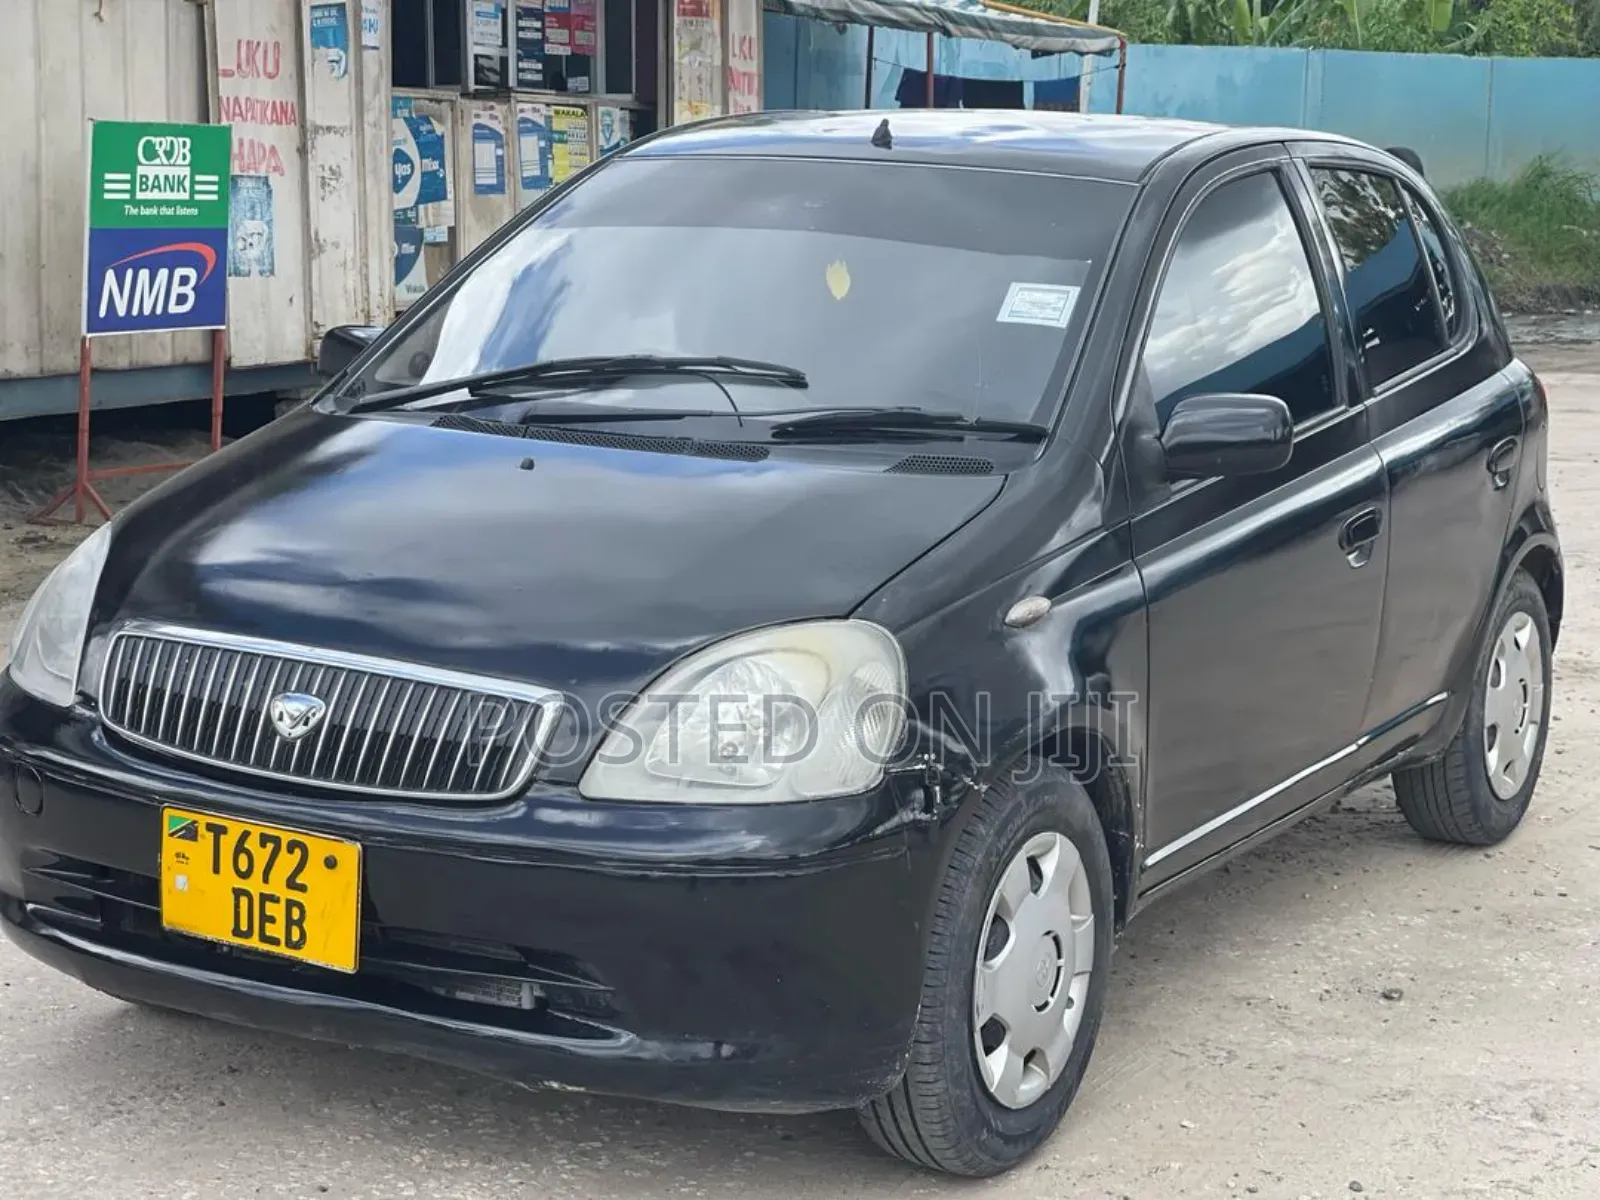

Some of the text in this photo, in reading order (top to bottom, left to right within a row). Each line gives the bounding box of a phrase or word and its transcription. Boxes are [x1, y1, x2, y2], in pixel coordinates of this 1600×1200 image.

[137, 136, 191, 165] CRDB
[138, 174, 188, 193] BANK
[124, 205, 199, 215] The bank that listens
[99, 267, 198, 318] NMB
[205, 822, 309, 893] T672
[231, 887, 307, 950] DEB
